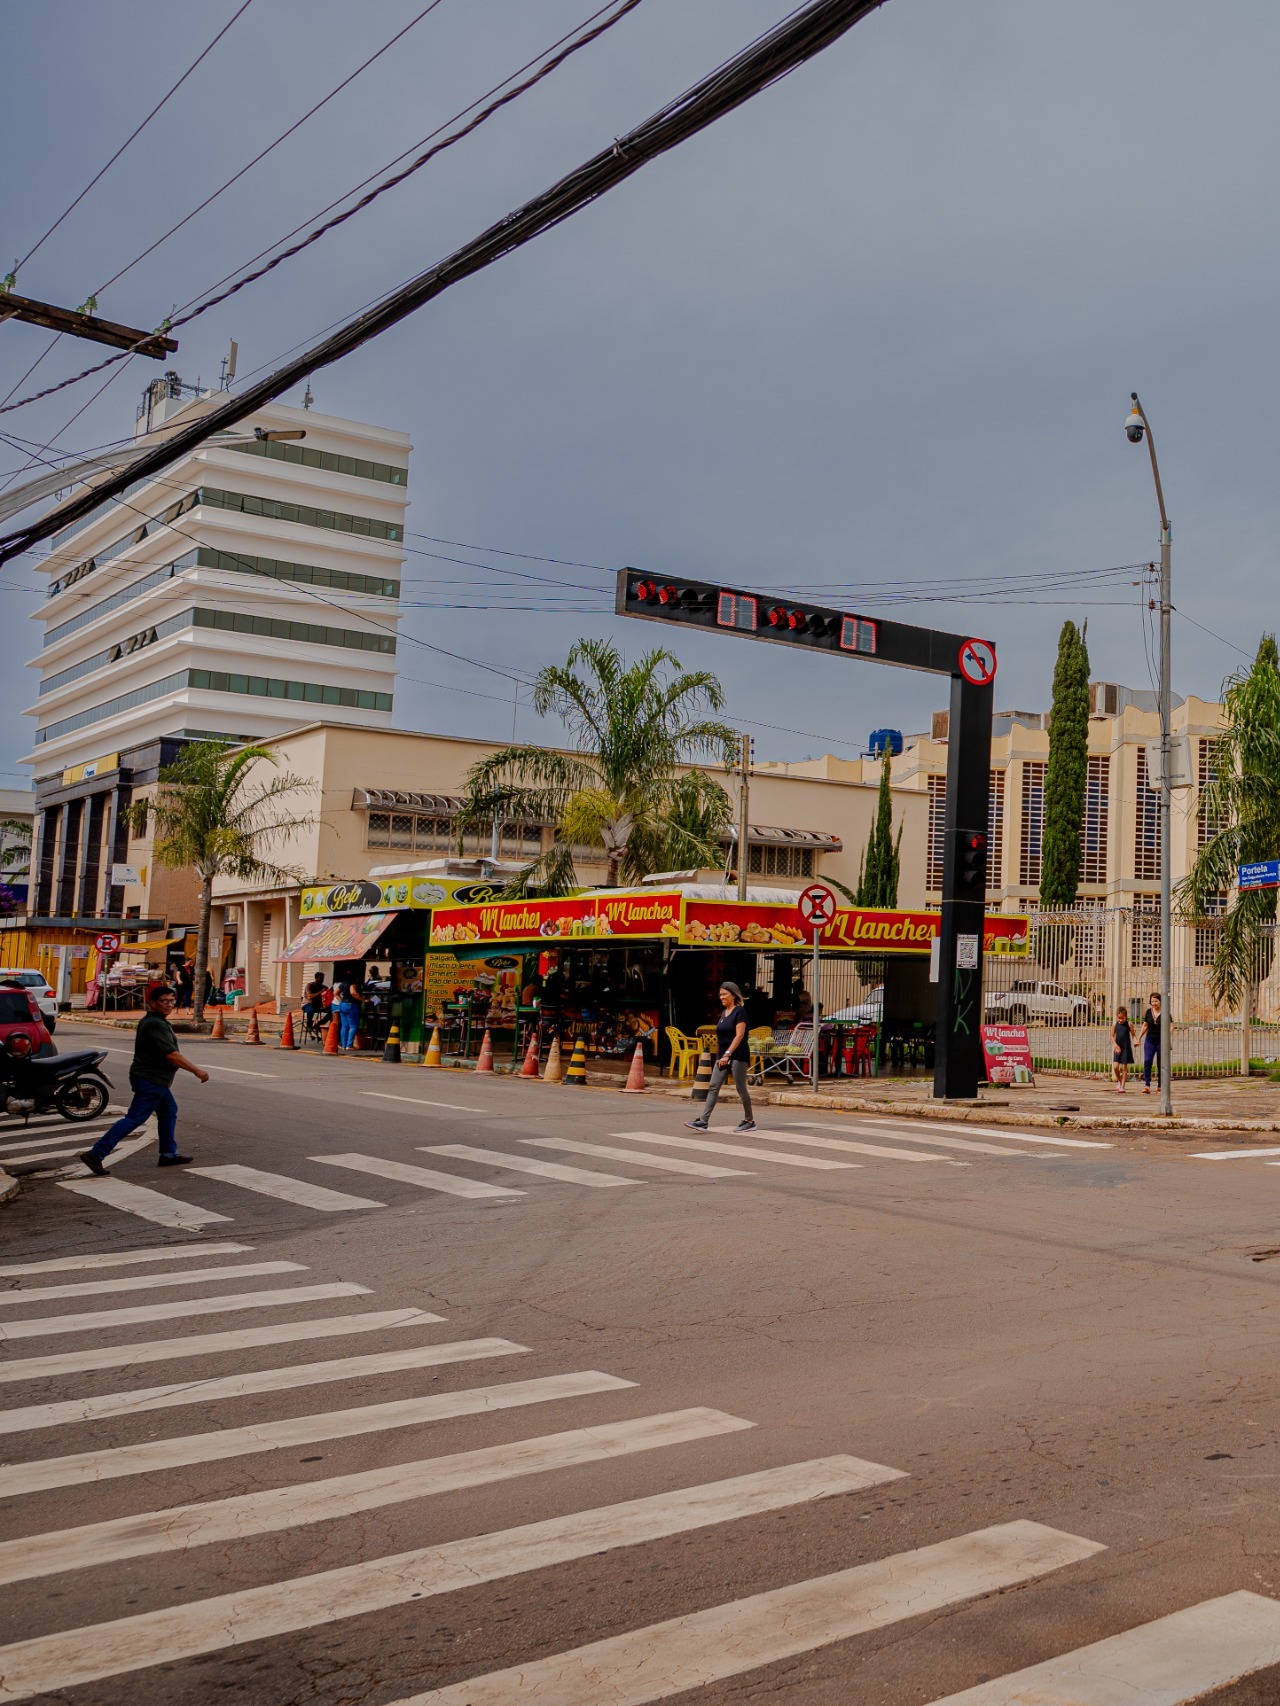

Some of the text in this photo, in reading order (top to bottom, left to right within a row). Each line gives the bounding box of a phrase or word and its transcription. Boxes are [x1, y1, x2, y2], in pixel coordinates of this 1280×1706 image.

[1241, 865, 1268, 875] Portela
[330, 884, 361, 911] Beto
[479, 906, 541, 938] WL lanches
[605, 901, 674, 927] WL lanches
[852, 913, 937, 942] lanches
[429, 954, 458, 963] Salgado
[429, 962, 450, 970] Misto
[984, 1027, 1026, 1040] WL lanches
